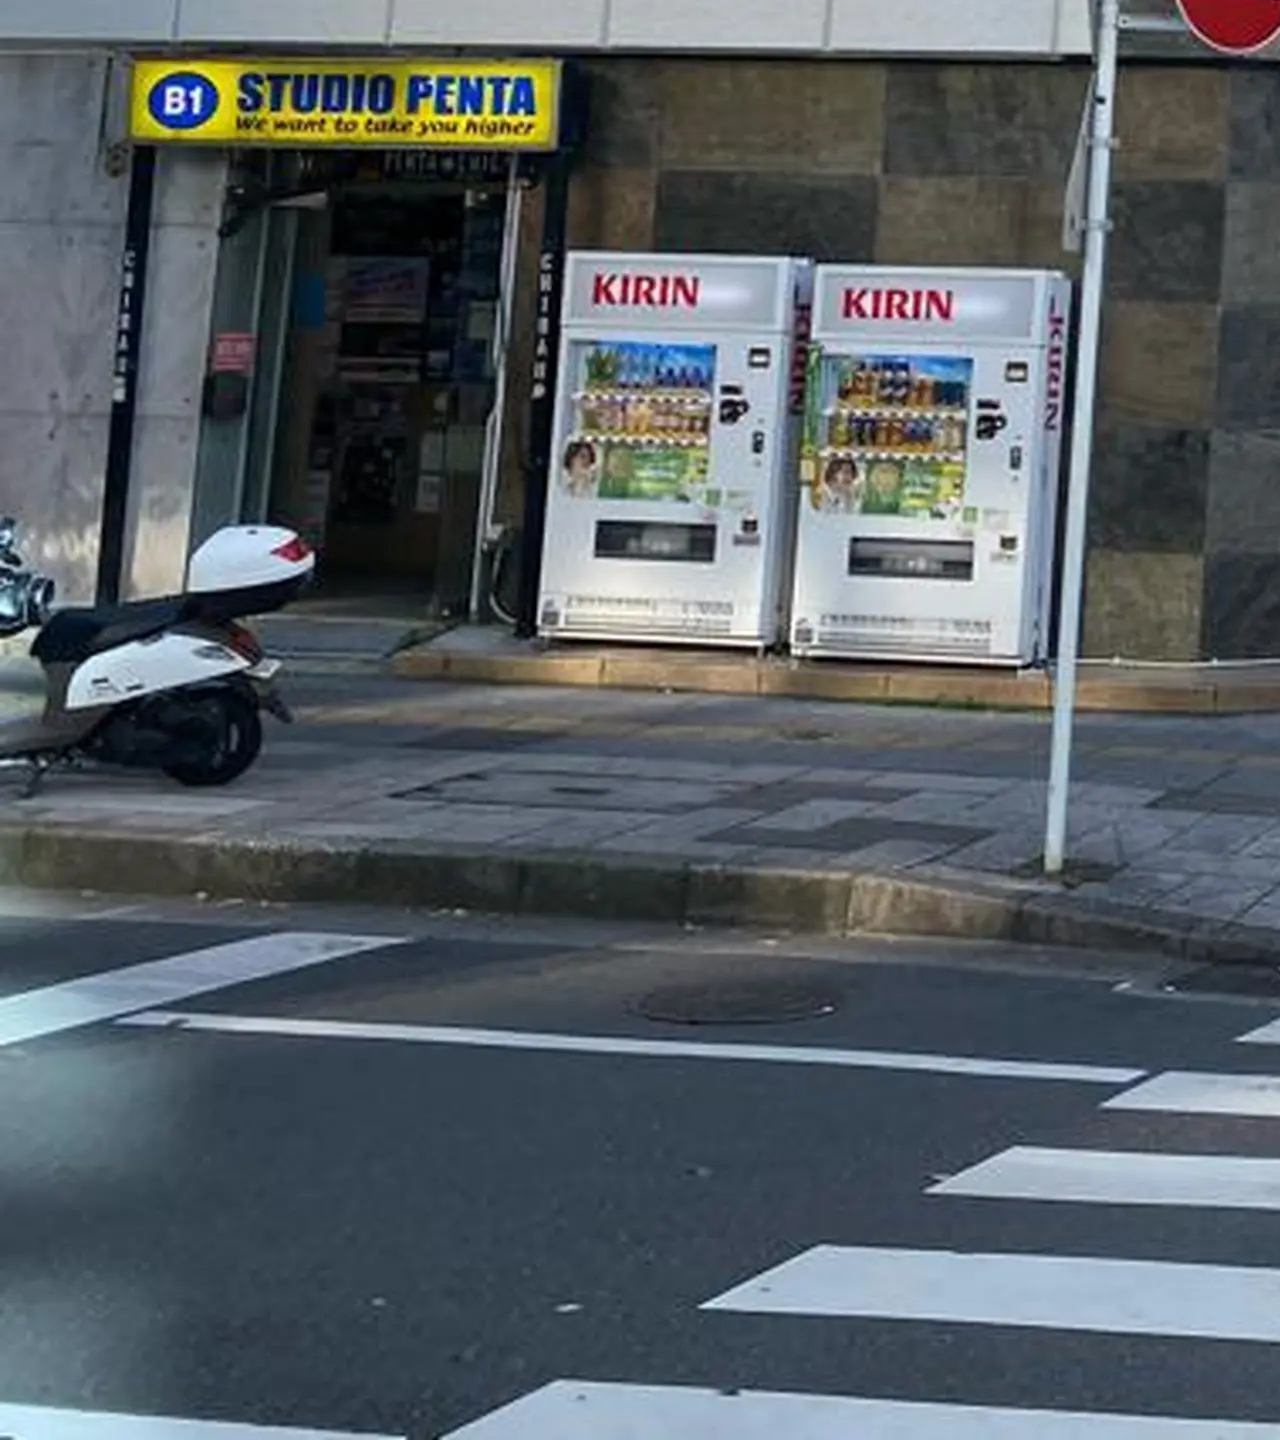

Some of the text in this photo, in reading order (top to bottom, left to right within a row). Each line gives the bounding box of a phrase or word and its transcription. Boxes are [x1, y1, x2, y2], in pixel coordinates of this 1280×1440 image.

[163, 85, 202, 115] B1
[236, 71, 537, 116] STUDIO PENTA
[235, 115, 536, 137] We want to take you higher
[592, 273, 700, 308] KIRIN
[841, 287, 954, 321] KIRIN
